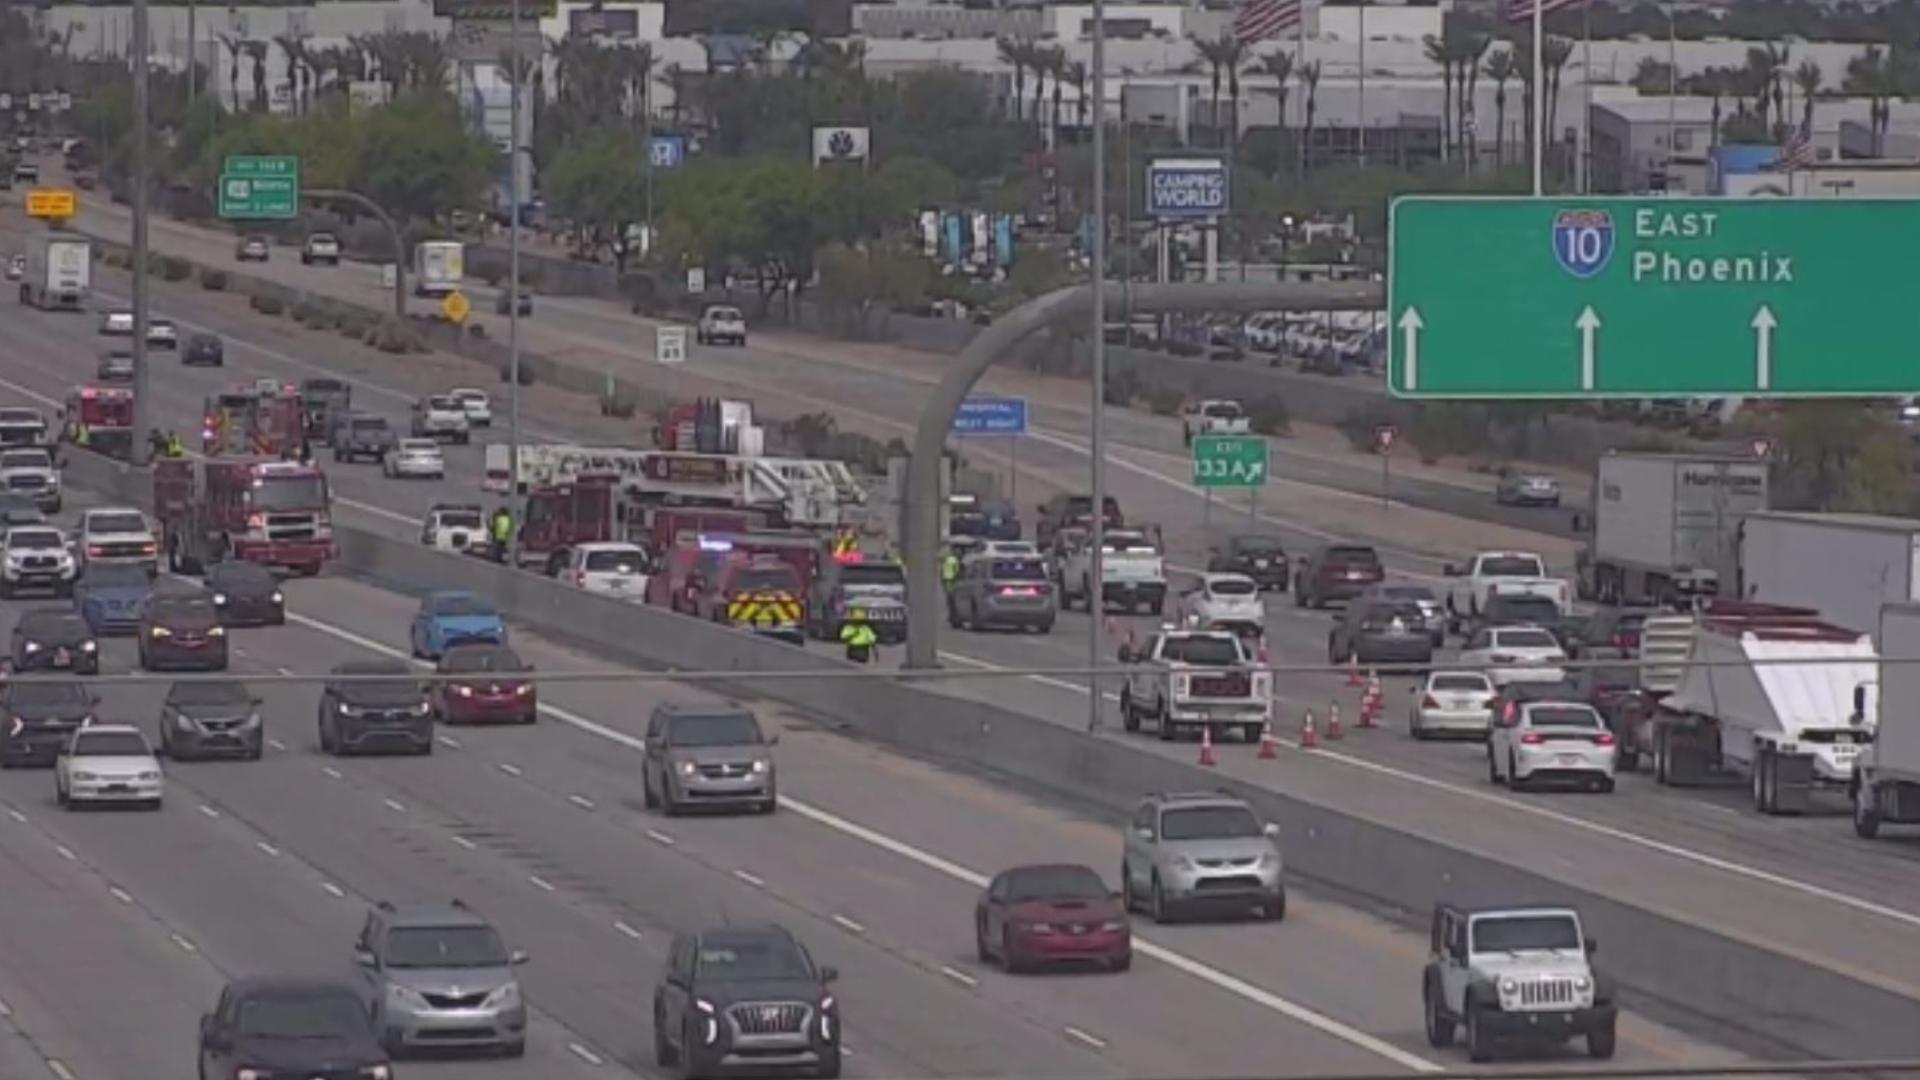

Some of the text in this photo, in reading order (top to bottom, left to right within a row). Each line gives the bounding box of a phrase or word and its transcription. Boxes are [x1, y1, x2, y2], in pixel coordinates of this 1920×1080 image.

[1154, 173, 1224, 188] CAMPING
[1155, 188, 1222, 207] WORLD
[1635, 208, 1718, 237] EAST
[1566, 228, 1601, 264] 10
[1634, 251, 1793, 282] Phoenix
